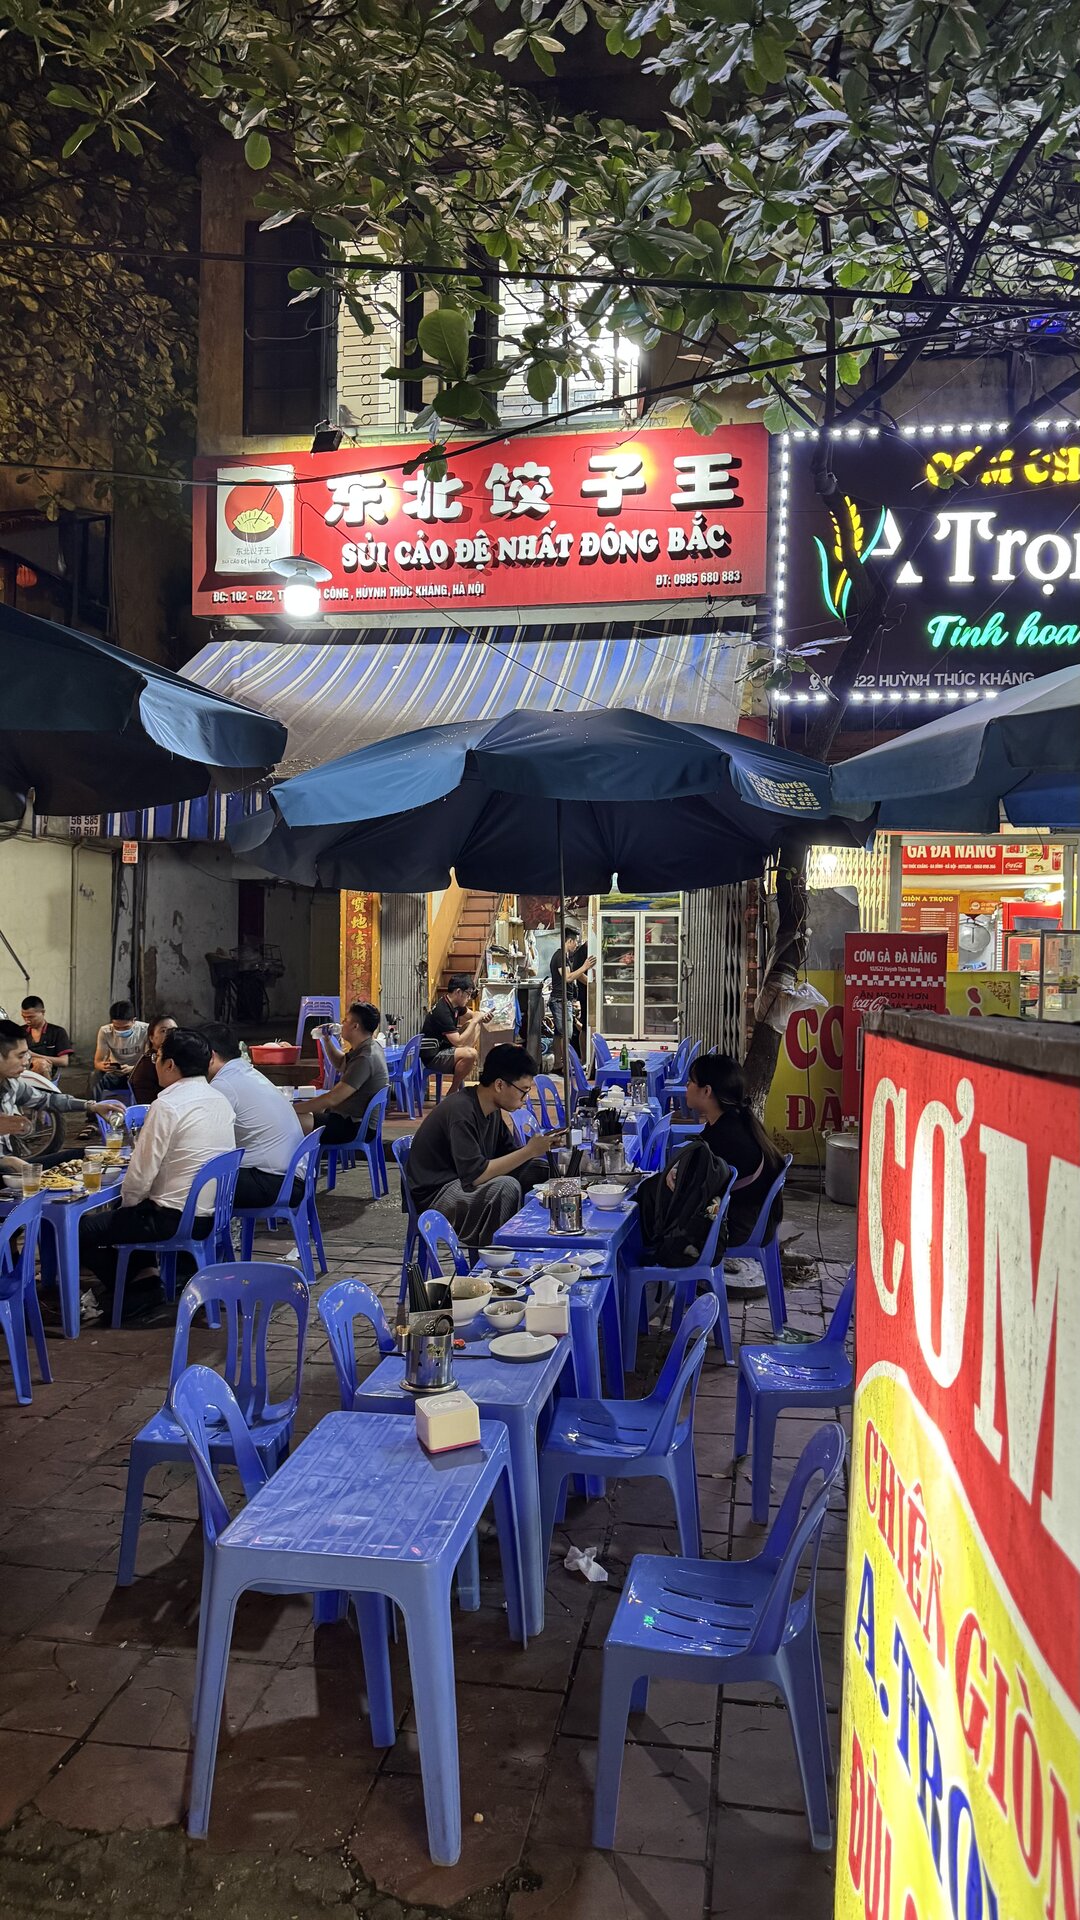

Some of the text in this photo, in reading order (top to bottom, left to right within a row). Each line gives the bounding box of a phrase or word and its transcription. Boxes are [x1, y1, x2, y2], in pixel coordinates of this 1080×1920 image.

[325, 452, 736, 526] 东北饺子王
[454, 529, 492, 570] ĐỆ
[497, 520, 574, 561] NHẤT
[580, 522, 659, 556] ĐÔNG
[667, 511, 726, 551] BẮC
[673, 572, 698, 585] 0985
[700, 571, 719, 583] 680
[721, 570, 741, 582] 883
[230, 591, 247, 603] 102
[878, 671, 930, 687] HUỲNH
[934, 670, 976, 686] THÚC
[979, 669, 1035, 686] KHÁNG
[853, 946, 938, 964] CƠM GÀ ĐÀ NẴNG
